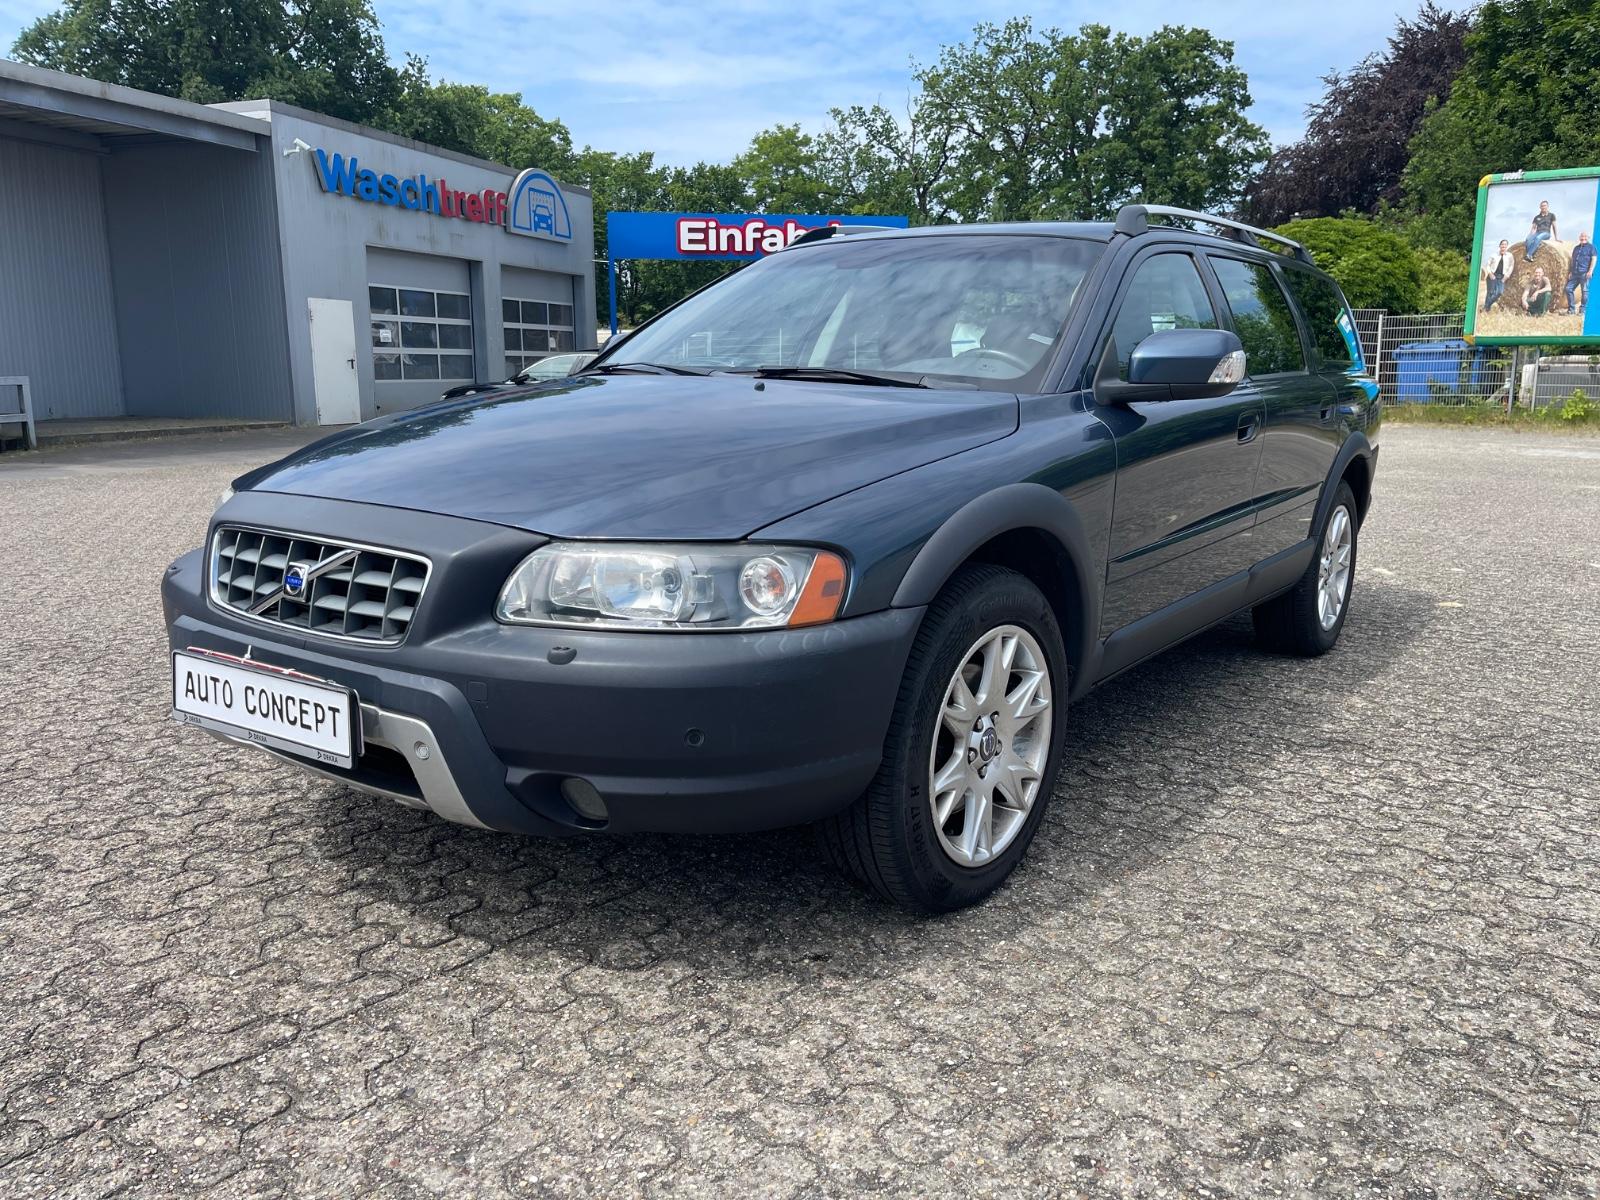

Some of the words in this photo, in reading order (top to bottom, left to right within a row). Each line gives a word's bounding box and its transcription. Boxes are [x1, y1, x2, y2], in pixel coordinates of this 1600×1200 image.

[314, 148, 507, 225] Waschtreff
[680, 220, 839, 252] Einfah
[185, 670, 233, 709] AUTO
[244, 685, 340, 738] CONCEPT
[253, 733, 268, 743] DEKRA
[322, 752, 339, 764] DEKRA
